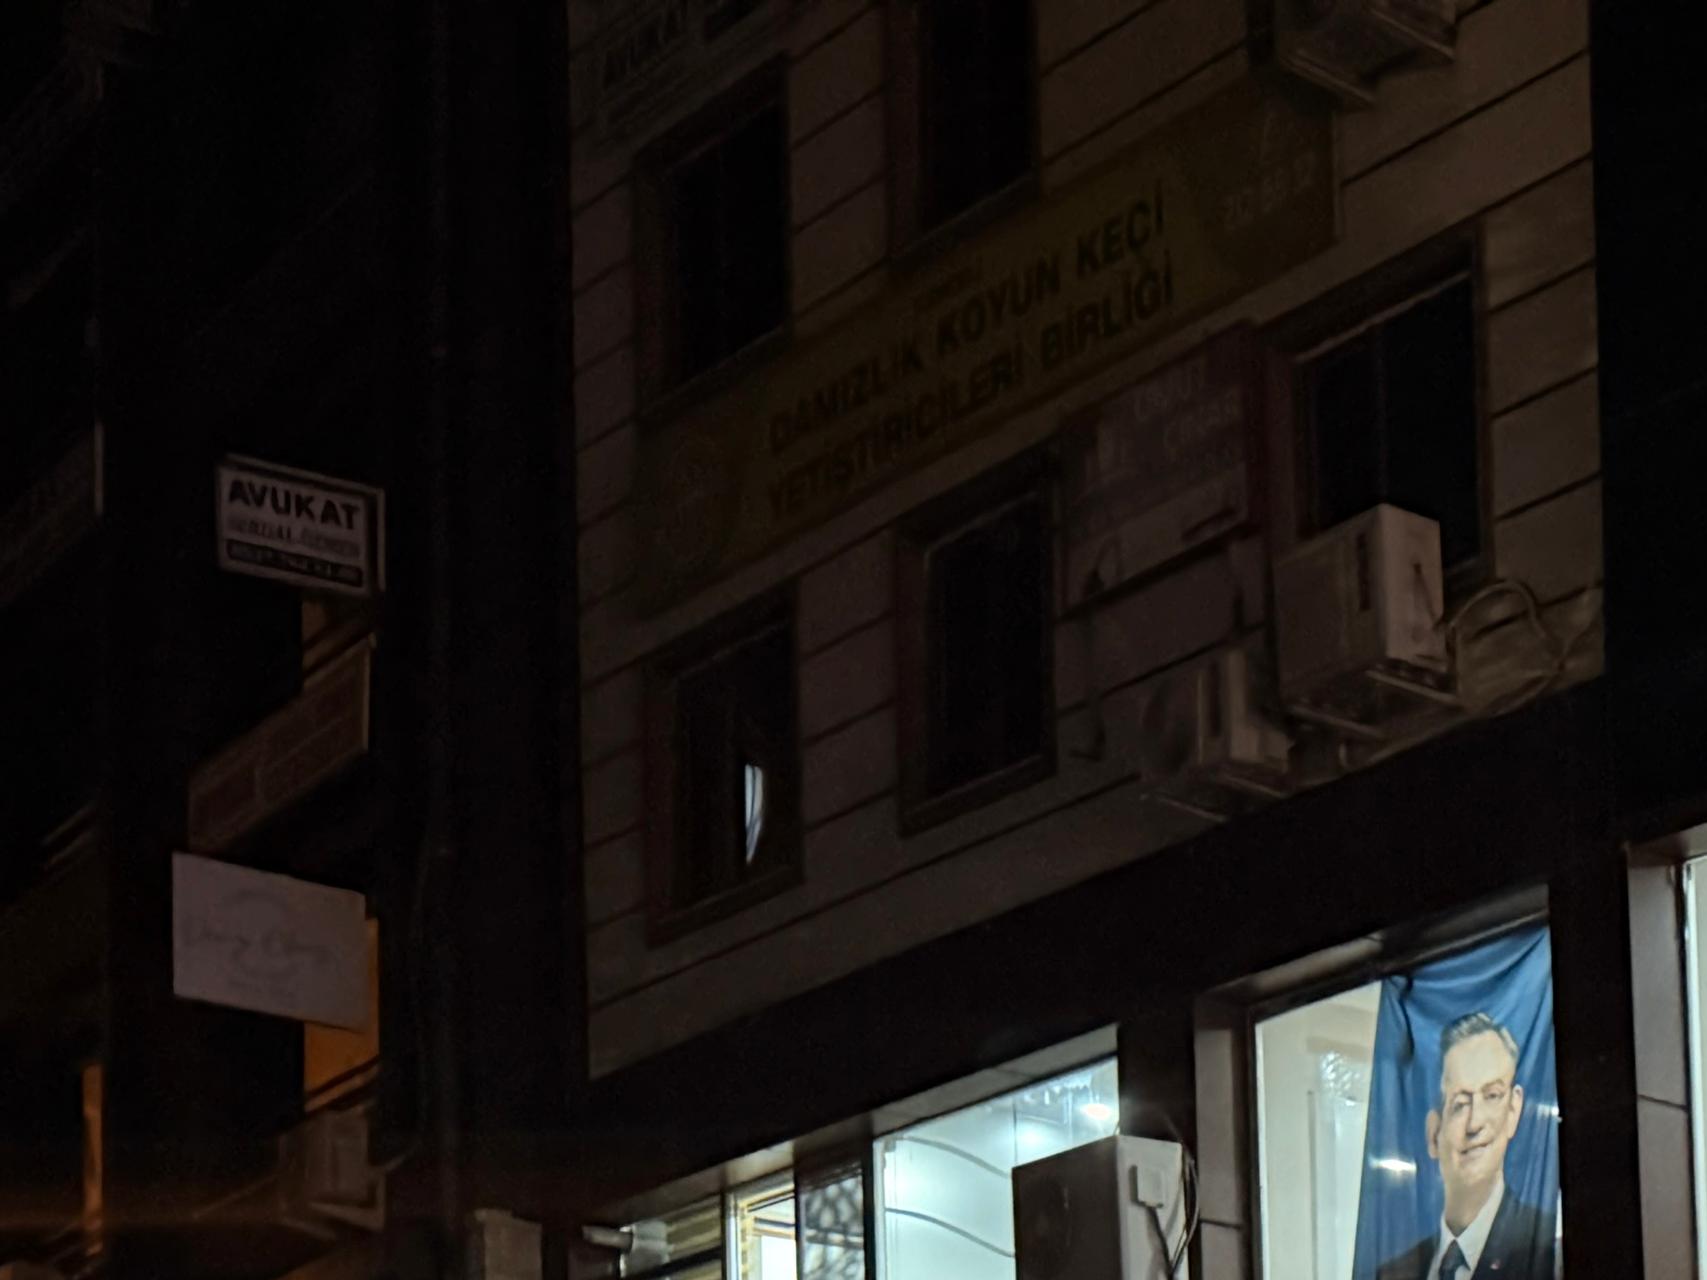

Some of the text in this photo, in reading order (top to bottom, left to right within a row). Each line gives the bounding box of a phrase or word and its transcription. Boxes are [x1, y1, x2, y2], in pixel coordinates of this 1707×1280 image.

[769, 337, 923, 455] DAMIZLIK
[938, 252, 1060, 357] KOYUN
[1041, 250, 1173, 369] BİRLİĞİ
[229, 478, 360, 531] AVUKAT
